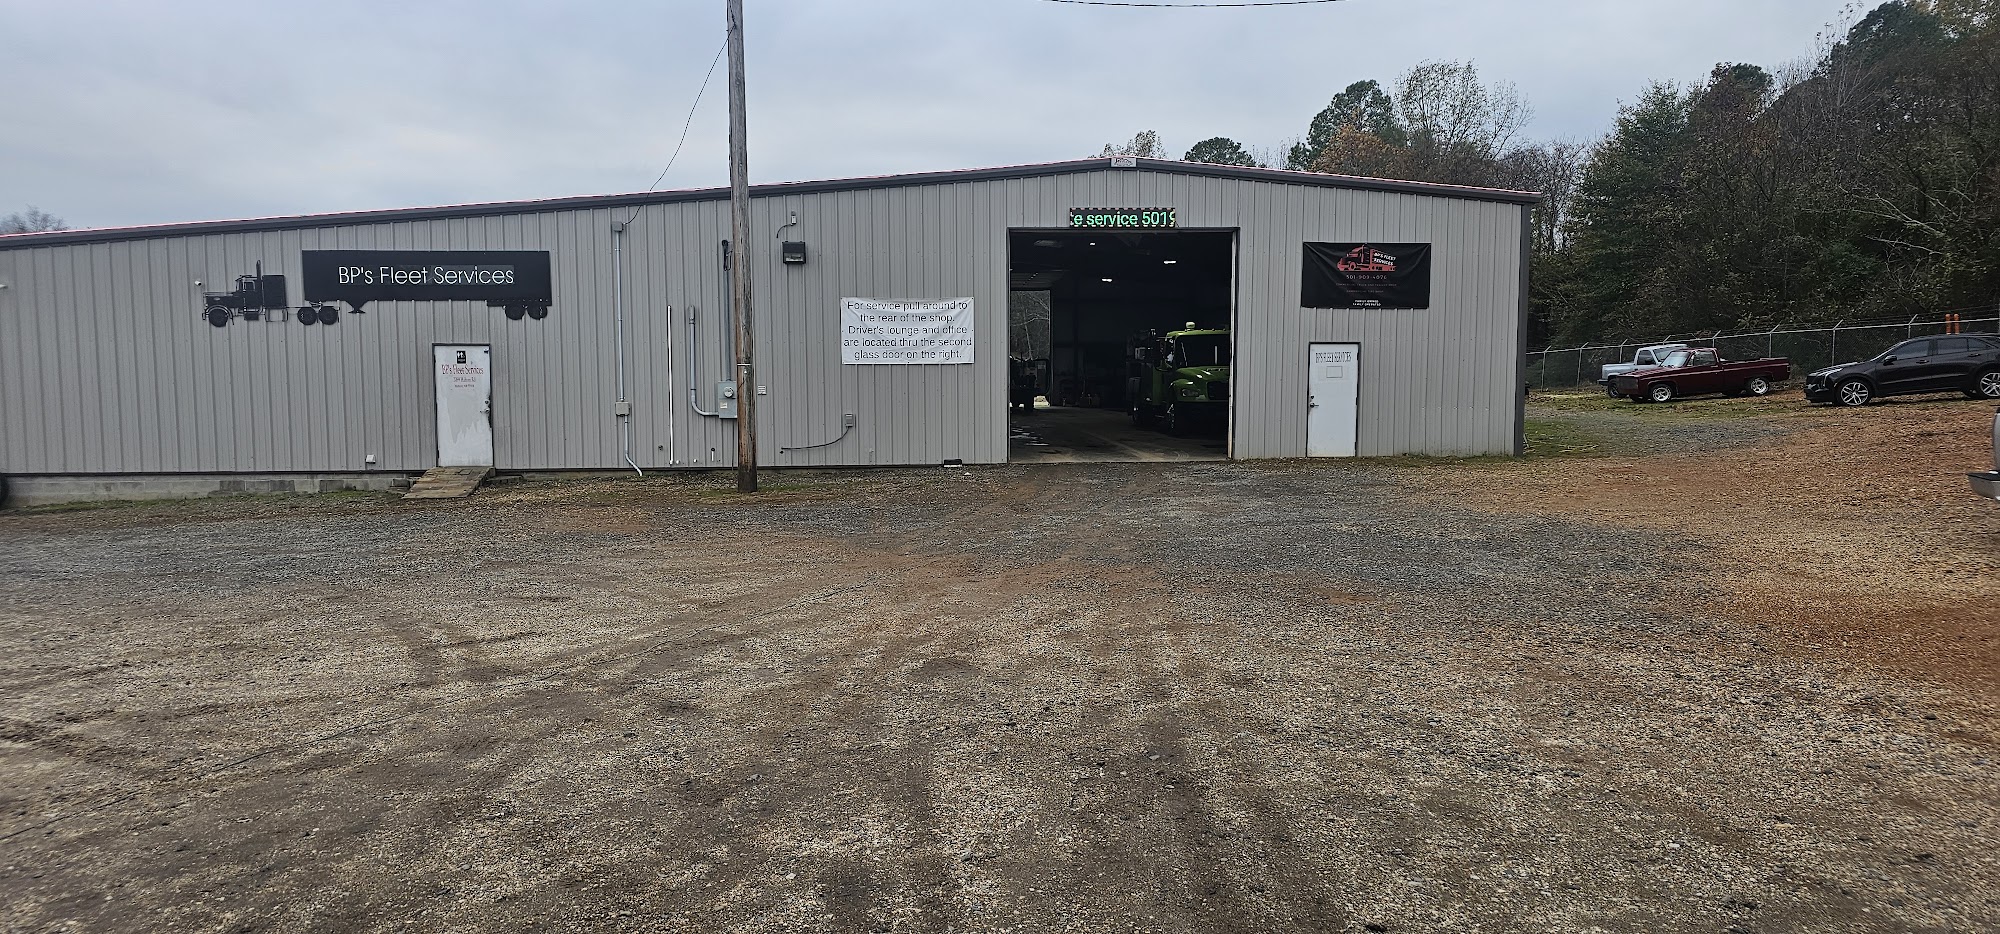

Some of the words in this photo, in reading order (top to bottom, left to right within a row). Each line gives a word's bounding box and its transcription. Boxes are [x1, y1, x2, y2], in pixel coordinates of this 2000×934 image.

[1086, 211, 1138, 225] service
[338, 266, 374, 285] BP's
[379, 266, 428, 285] Fleet
[433, 265, 514, 285] Services
[847, 302, 863, 310] For
[866, 301, 901, 310] service
[903, 301, 920, 312] pull
[923, 301, 956, 310] around
[958, 302, 968, 310] to
[860, 314, 875, 322] the
[900, 313, 910, 322] of
[912, 313, 927, 322] the
[929, 314, 955, 323] shop.
[848, 325, 884, 334] Driver's
[887, 326, 919, 336] lounge
[922, 325, 939, 334] and
[942, 325, 967, 334] office
[862, 338, 897, 346] located
[899, 338, 918, 346] thru
[921, 338, 935, 346] the
[938, 337, 972, 346] second
[854, 350, 880, 360] glass
[882, 350, 904, 359] door
[906, 351, 918, 359] on
[921, 350, 936, 359] the
[938, 349, 962, 360] right.
[452, 363, 465, 375] Fleet
[465, 363, 484, 375] Services
